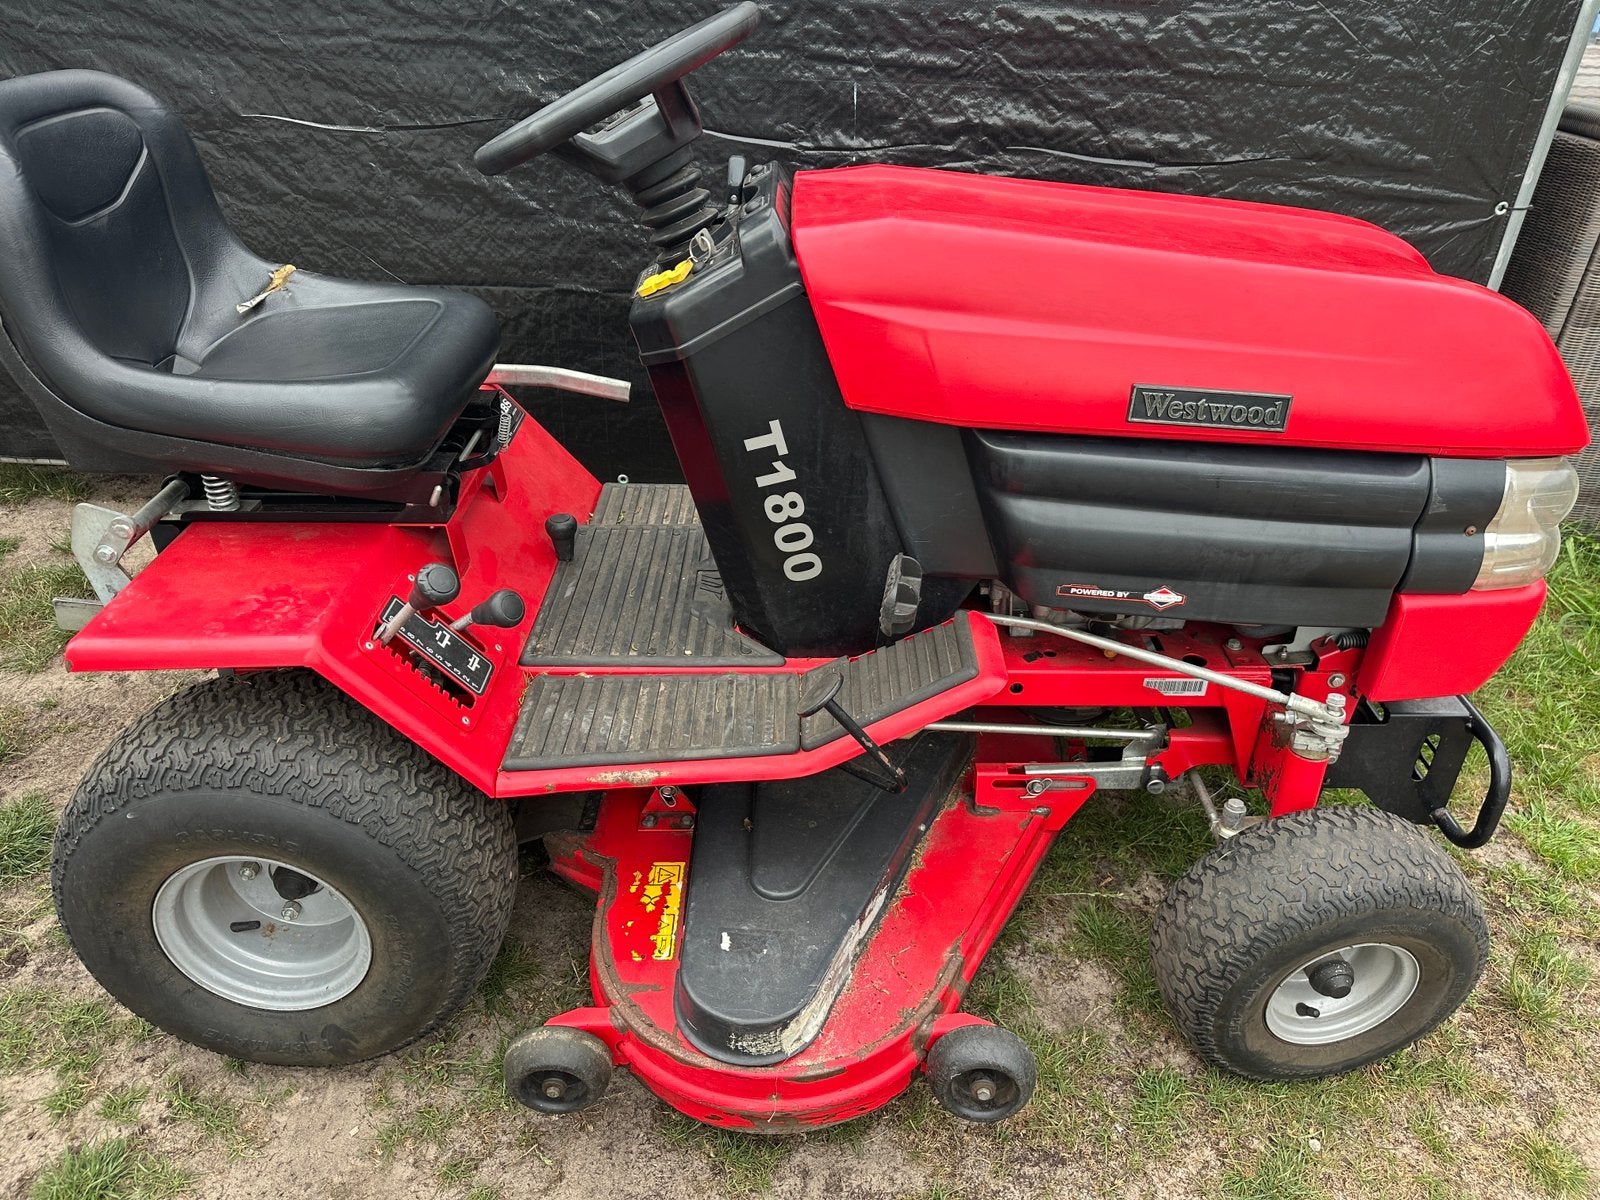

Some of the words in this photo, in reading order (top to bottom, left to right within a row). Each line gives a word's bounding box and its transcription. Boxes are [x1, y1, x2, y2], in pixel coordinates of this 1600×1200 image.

[1142, 391, 1283, 425] Westwood
[743, 419, 823, 582] T1800
[1070, 587, 1115, 597] POWERED
[1116, 591, 1130, 599] BY
